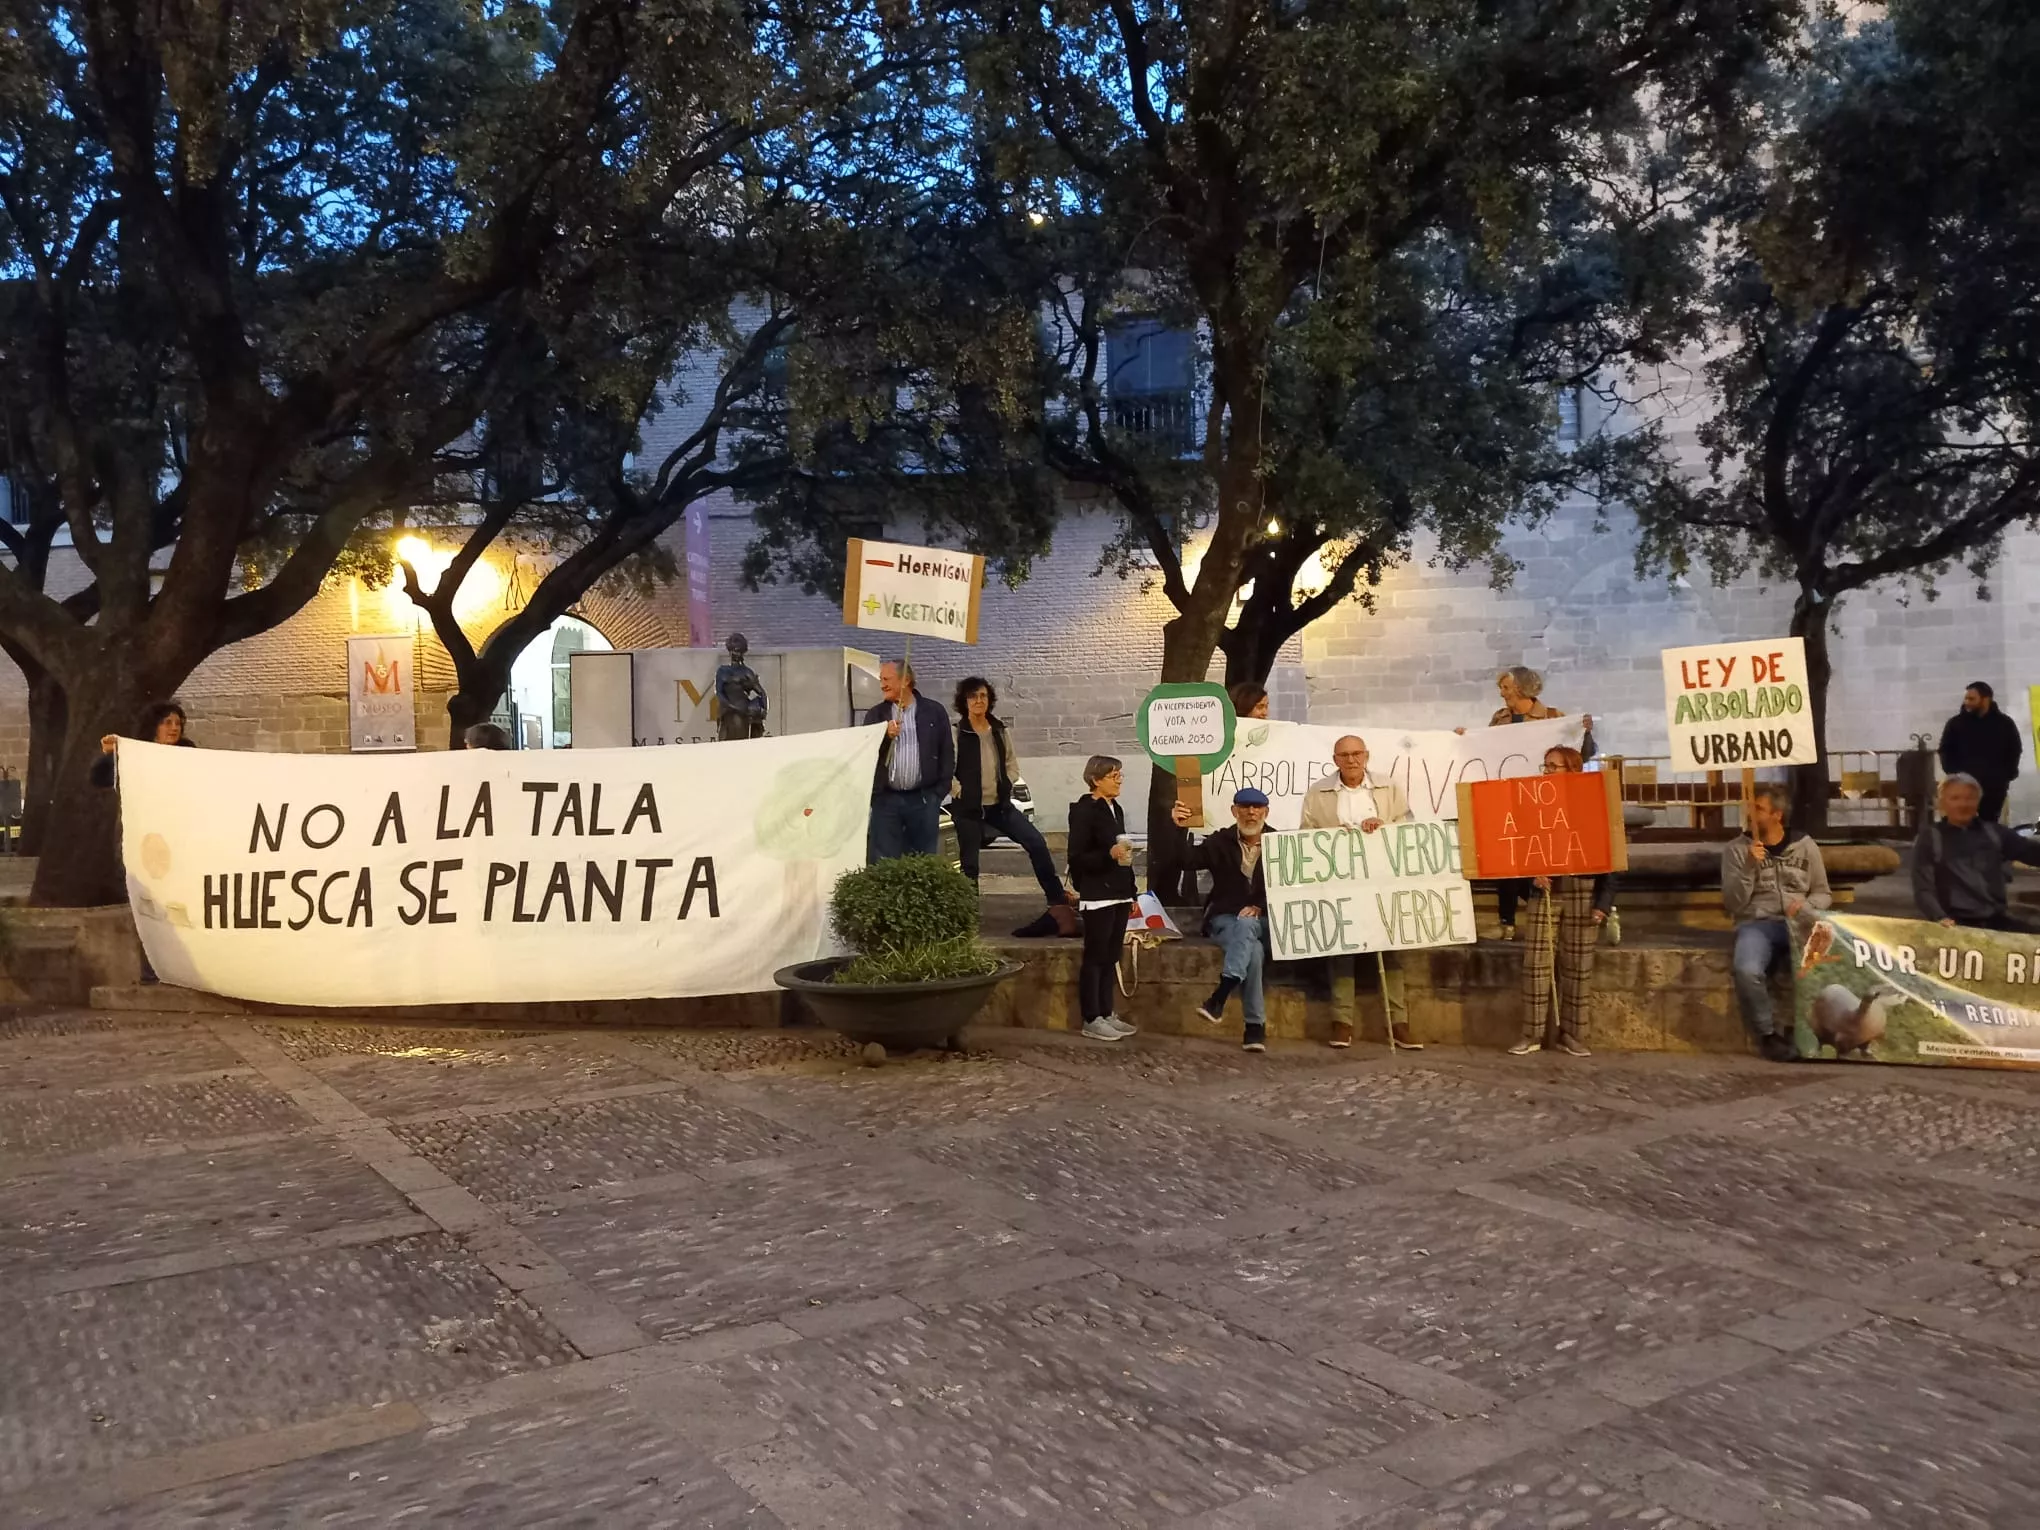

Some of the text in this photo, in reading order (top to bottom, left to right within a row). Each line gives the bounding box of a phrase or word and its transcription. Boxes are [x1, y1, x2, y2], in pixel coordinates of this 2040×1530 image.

[1680, 652, 1786, 690] LEY DE
[1164, 701, 1217, 711] VICEPRESIDENTA
[1164, 715, 1208, 727] VOTA NO
[1674, 683, 1803, 725] ARBOLADO
[1152, 734, 1214, 745] AGENDA 2030
[1690, 728, 1793, 765] URBANO
[1518, 780, 1558, 806] NO
[249, 781, 662, 853] NO A LA TALA
[1503, 807, 1570, 835] A LA
[1264, 820, 1463, 889] HUESCA VERDE
[1498, 831, 1587, 867] TALA
[203, 856, 721, 931] HUESCA SE PLANTA
[1268, 886, 1468, 956] VERDE, VERDE
[1852, 938, 1919, 976] POR
[1938, 946, 1985, 982] UN
